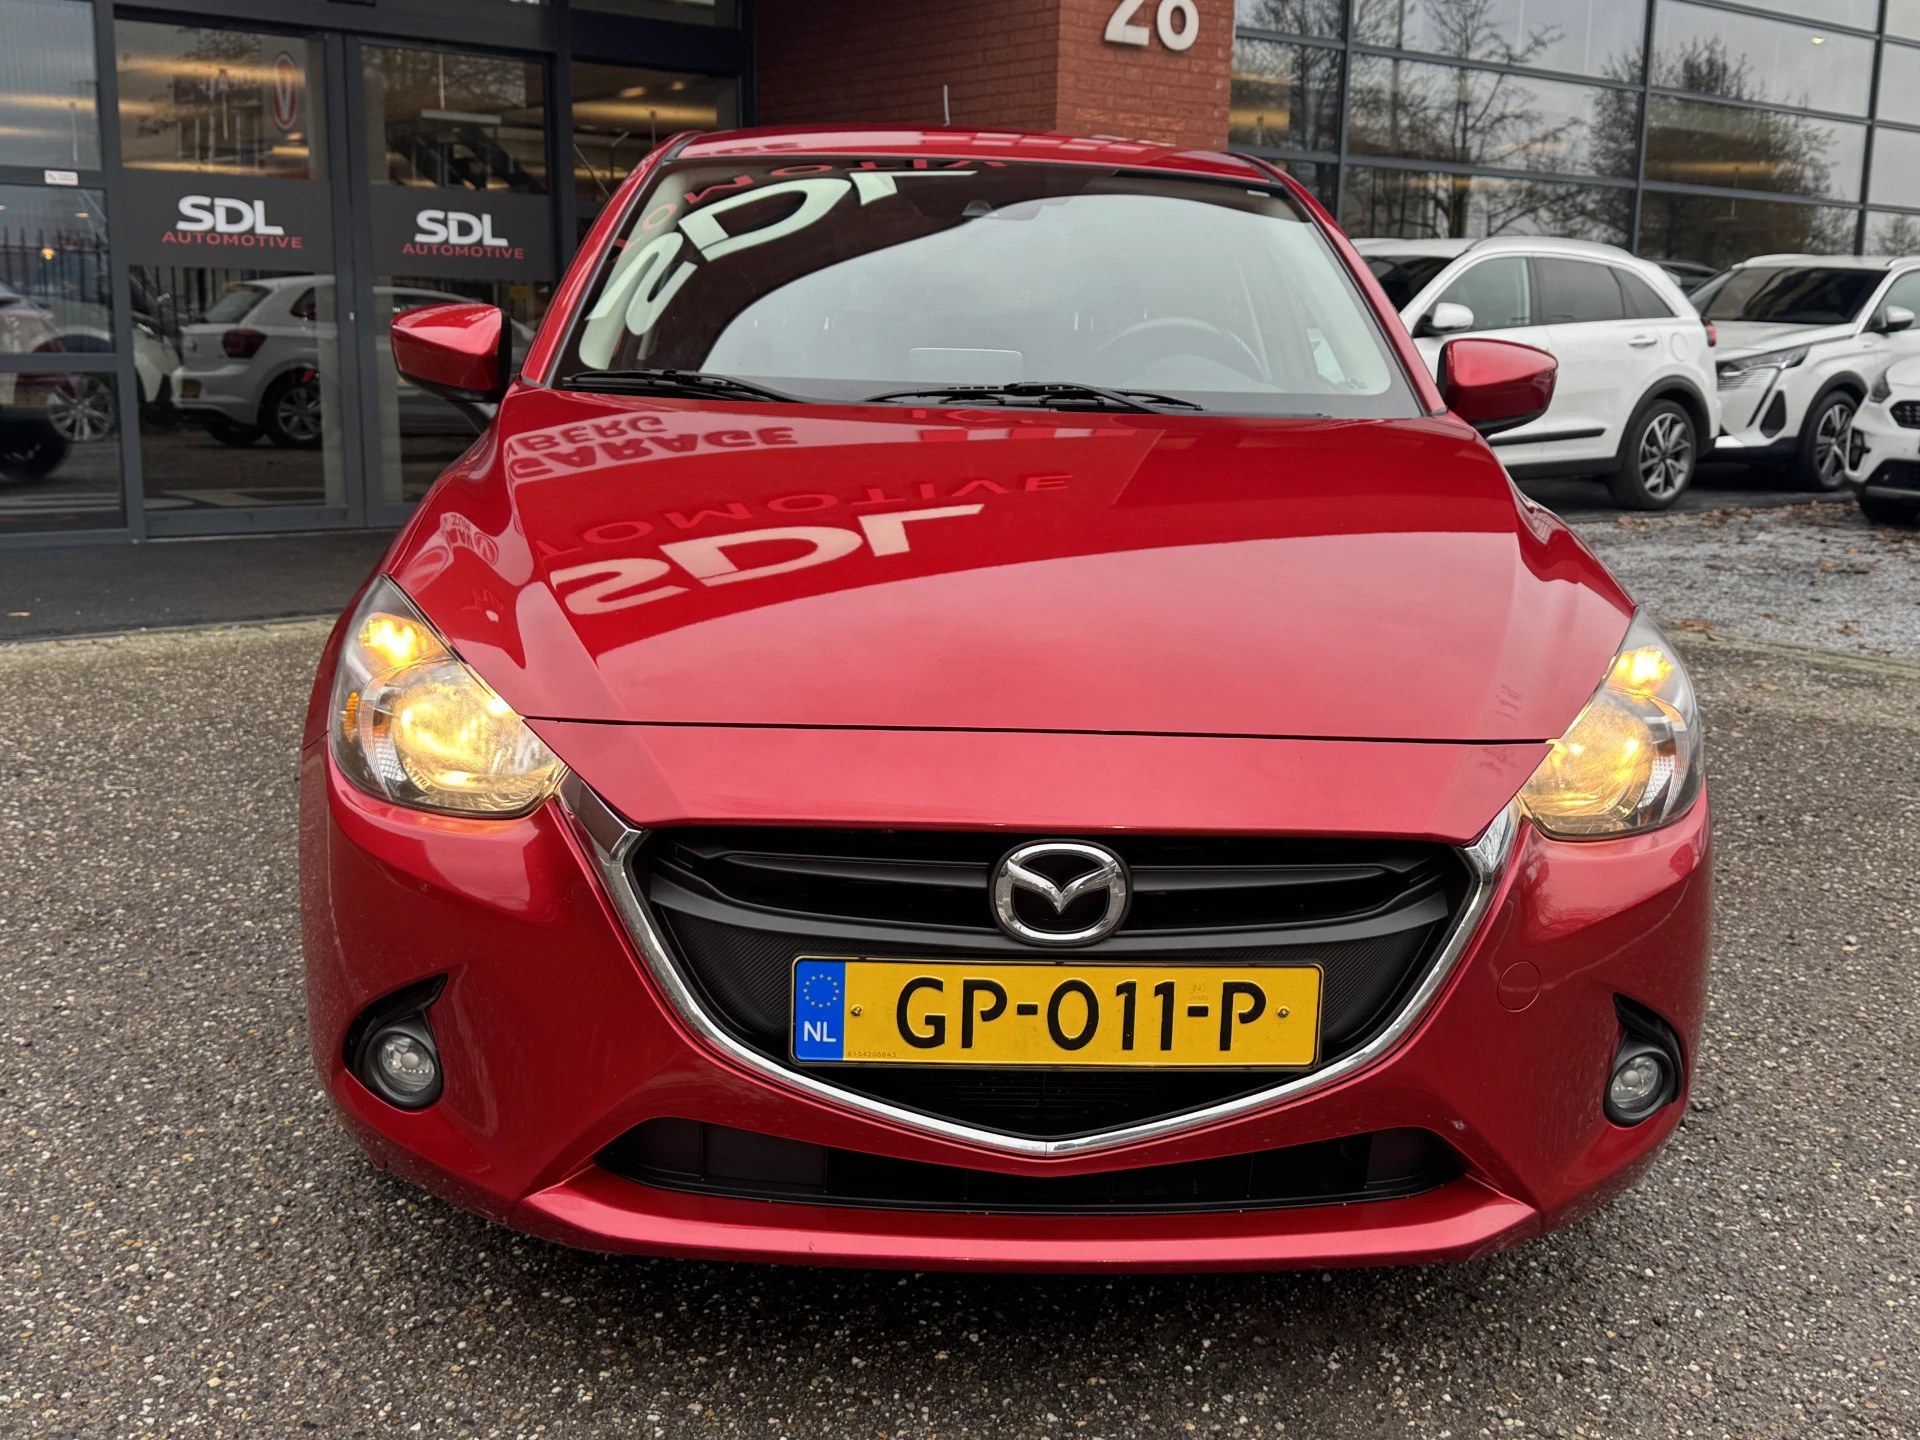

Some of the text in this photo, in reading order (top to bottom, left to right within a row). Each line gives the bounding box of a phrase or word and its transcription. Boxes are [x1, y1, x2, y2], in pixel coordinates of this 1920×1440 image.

[176, 195, 285, 235] SDL
[414, 209, 509, 247] SDL
[162, 231, 303, 249] AUTOMOTIVE
[402, 243, 525, 260] AUTOMOTIVE
[896, 976, 1267, 1052] GP-011-P
[803, 1021, 836, 1043] NL
